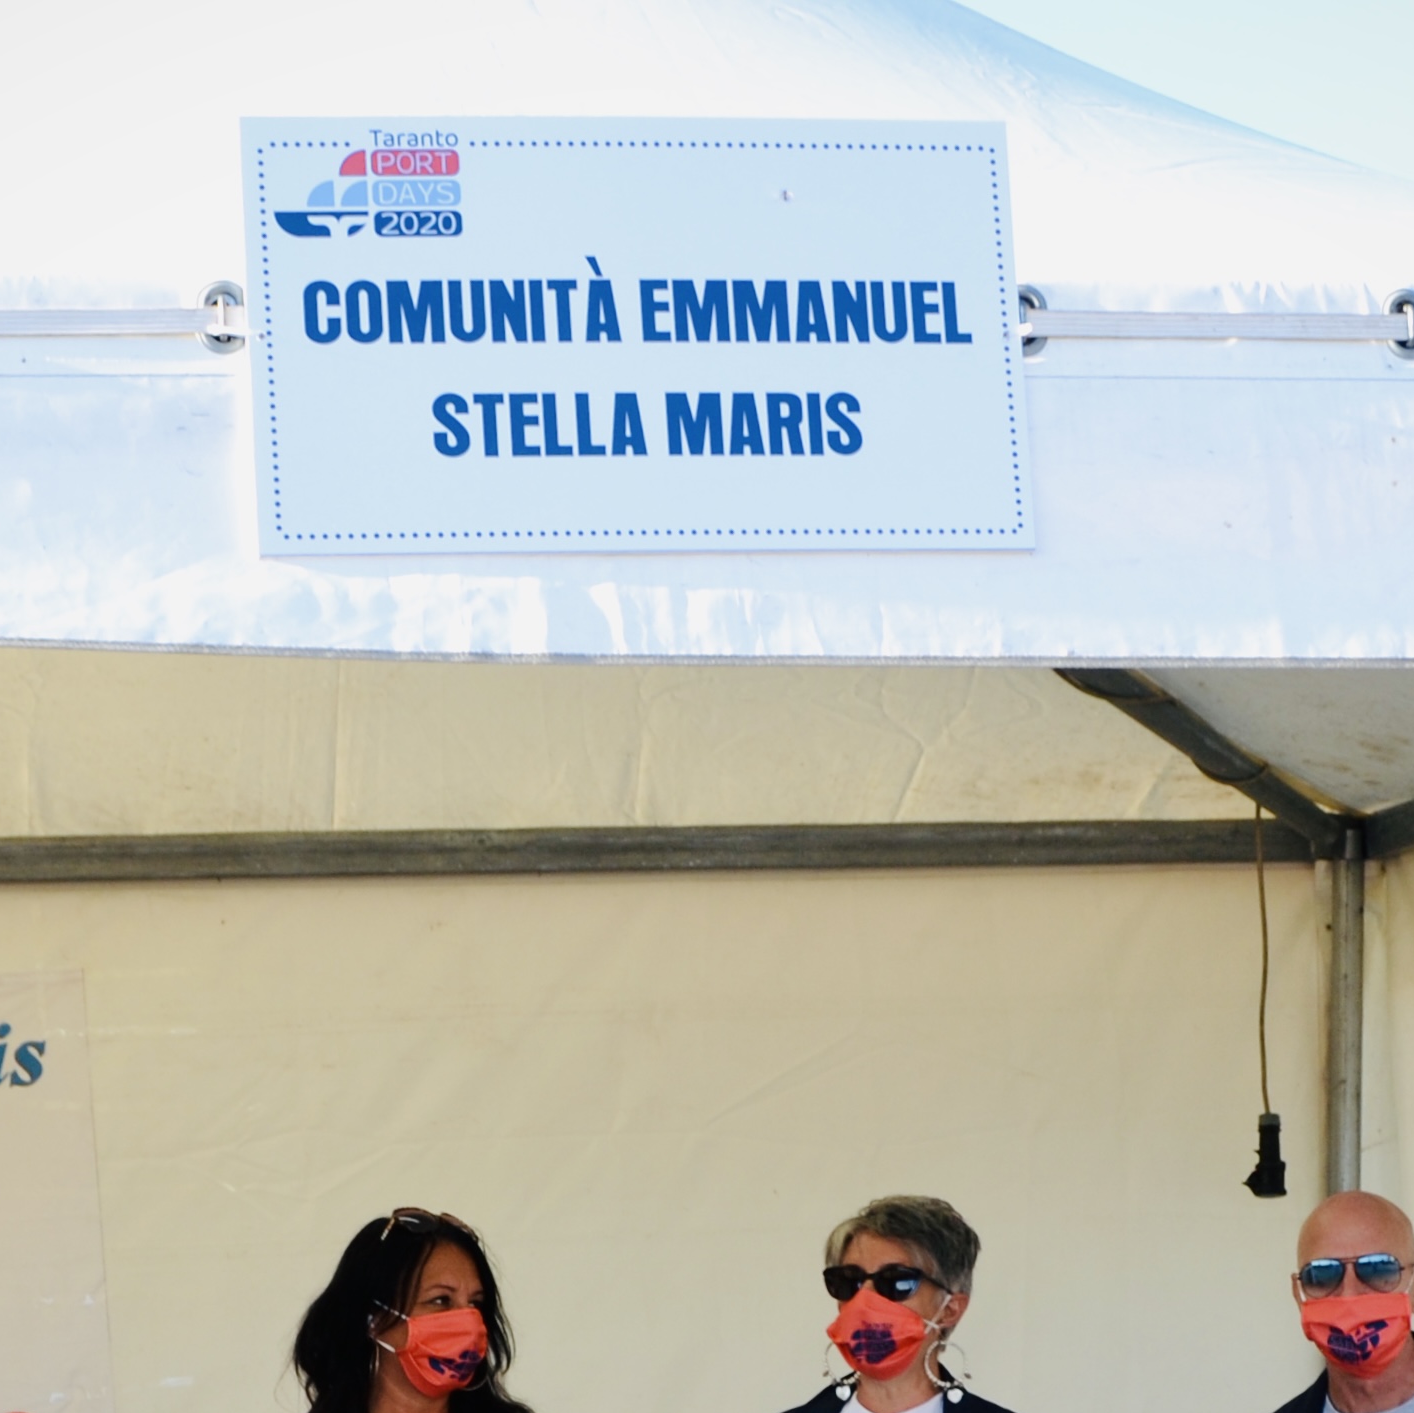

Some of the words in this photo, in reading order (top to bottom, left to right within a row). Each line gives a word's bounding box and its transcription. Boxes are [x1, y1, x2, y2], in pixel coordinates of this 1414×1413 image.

[369, 129, 459, 148] Taranto
[376, 151, 452, 174] PORT
[377, 182, 455, 205] DAYS
[380, 212, 457, 236] 2020
[303, 256, 622, 344] COMUNITÀ
[639, 279, 973, 344] EMMANUEL
[432, 392, 648, 457] STELLA
[665, 392, 863, 457] MARIS
